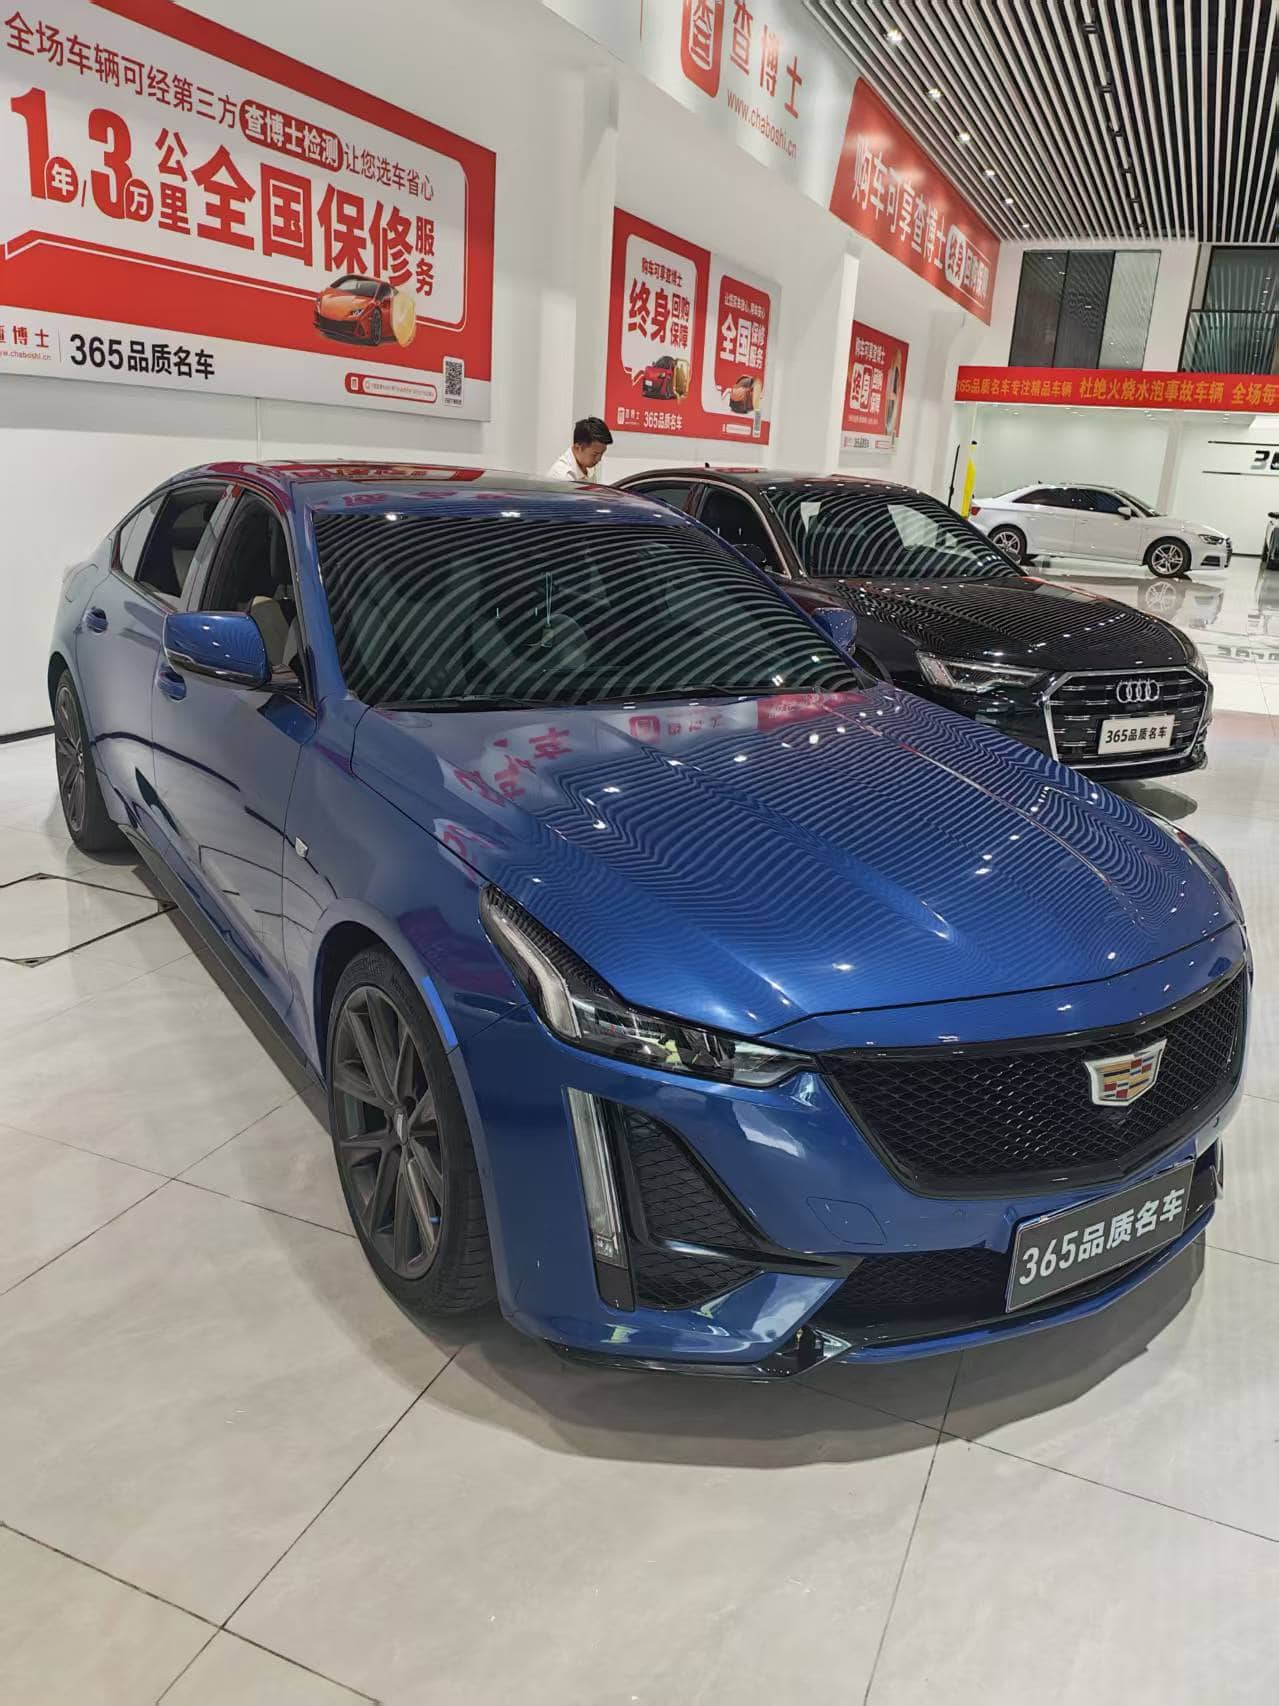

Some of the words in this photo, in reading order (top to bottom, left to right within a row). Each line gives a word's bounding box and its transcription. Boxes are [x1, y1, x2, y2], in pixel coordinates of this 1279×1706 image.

[4, 10, 239, 129] 全场车辆可经第三方
[243, 103, 341, 169] 查博士检测
[344, 142, 435, 202] 让您选车省心
[727, 88, 798, 160] www.chaboshi.cn
[627, 277, 671, 344] 终身
[719, 312, 753, 367] 全国
[70, 333, 216, 380] 365品质名车
[643, 411, 683, 431] 365品质名车
[1105, 726, 1168, 744] 365品质名车
[1018, 1188, 1186, 1286] 365品质名车
